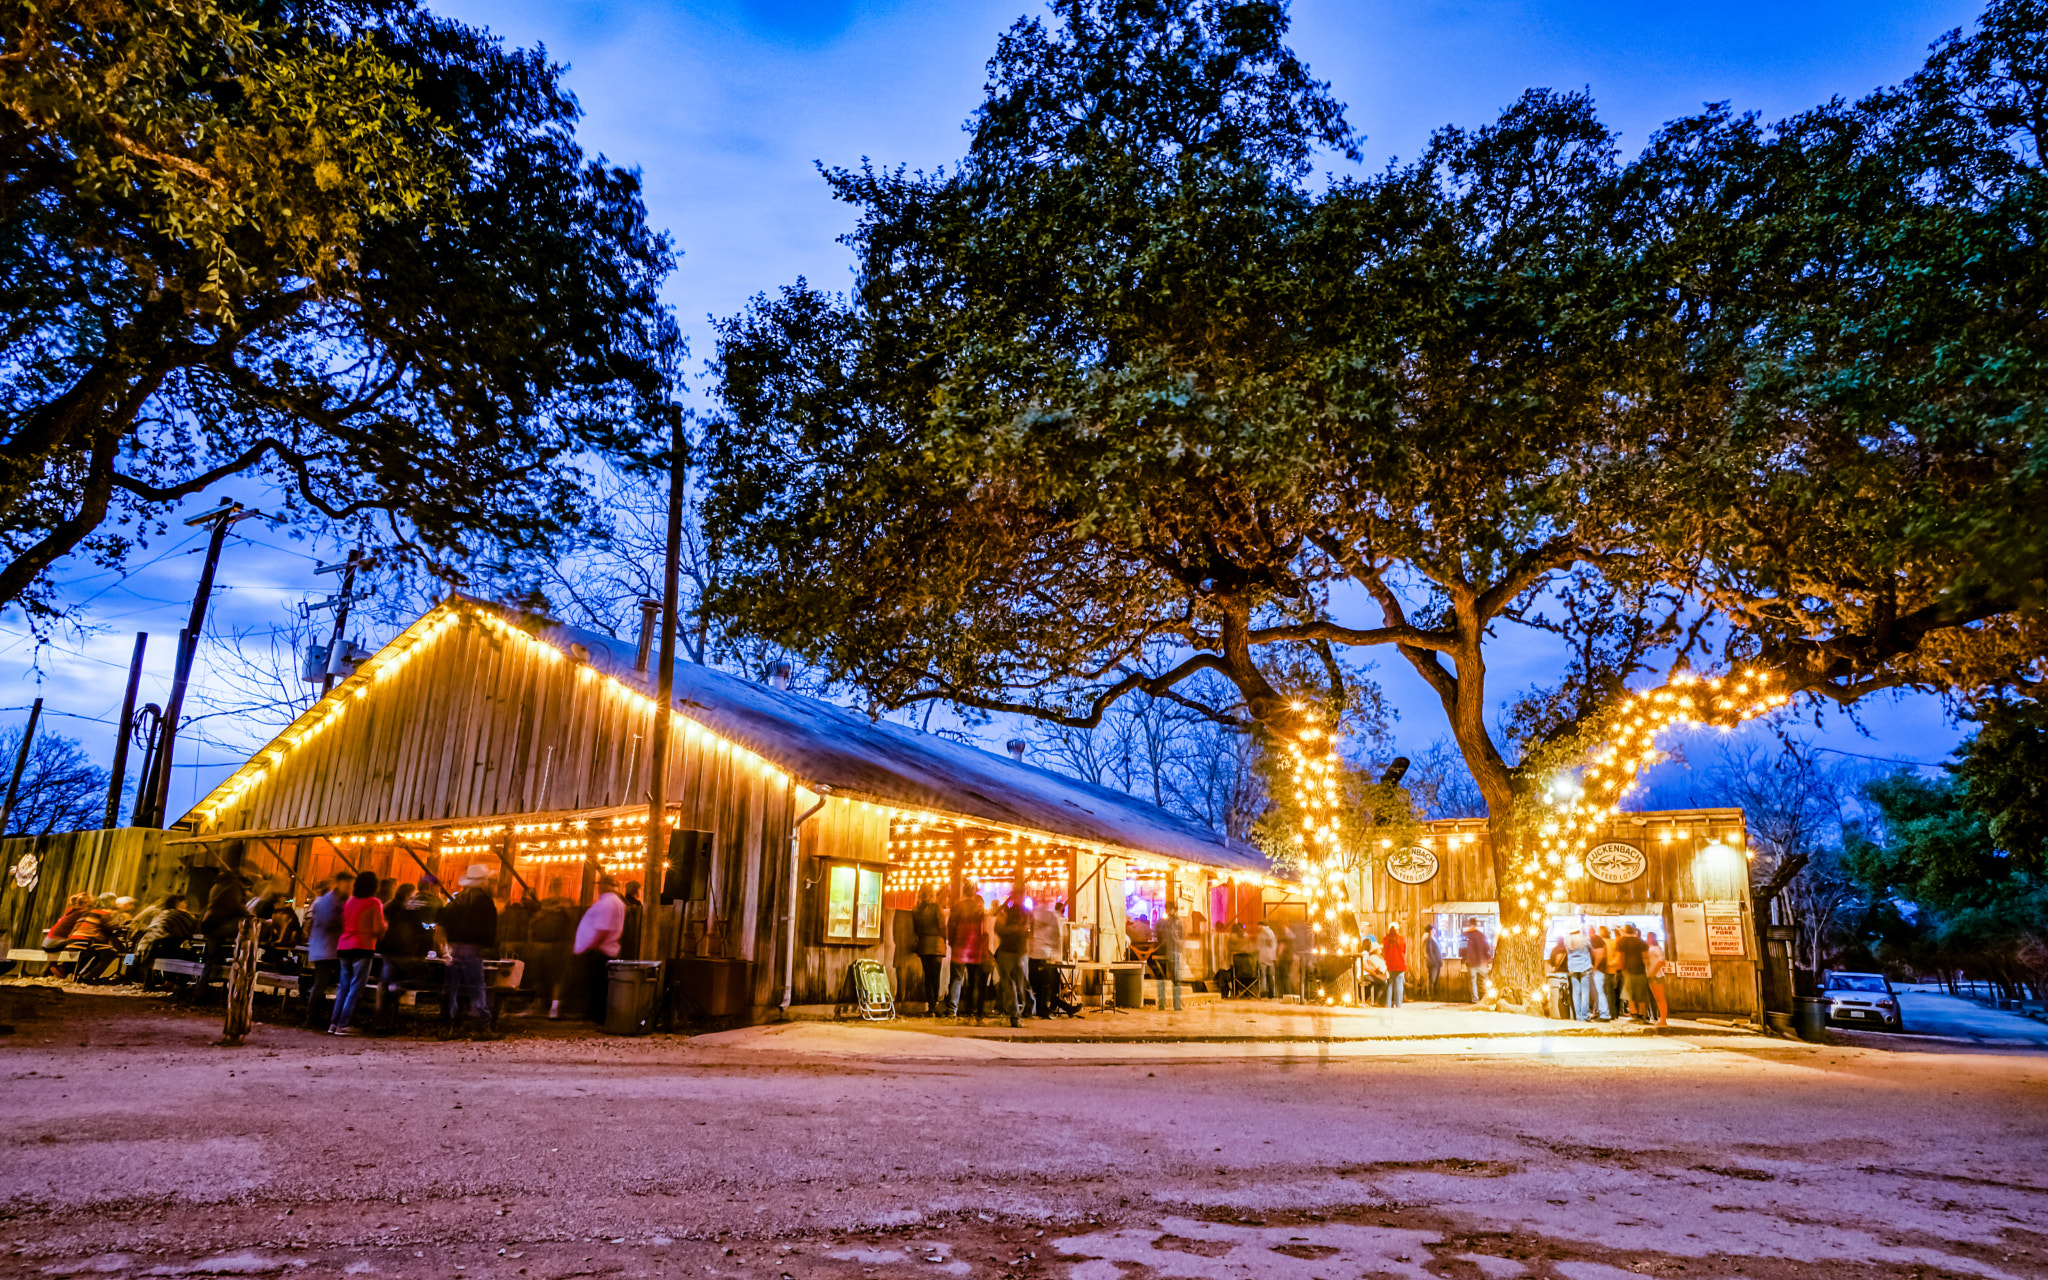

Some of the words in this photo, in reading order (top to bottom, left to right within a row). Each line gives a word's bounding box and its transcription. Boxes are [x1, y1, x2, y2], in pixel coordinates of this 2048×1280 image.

[1389, 847, 1435, 864] LUNBACH
[1587, 844, 1642, 863] LUCKENBACH
[1399, 872, 1414, 881] FEED
[1415, 872, 1425, 881] LOT
[1600, 871, 1618, 881] FEED
[1619, 871, 1631, 881] LOT
